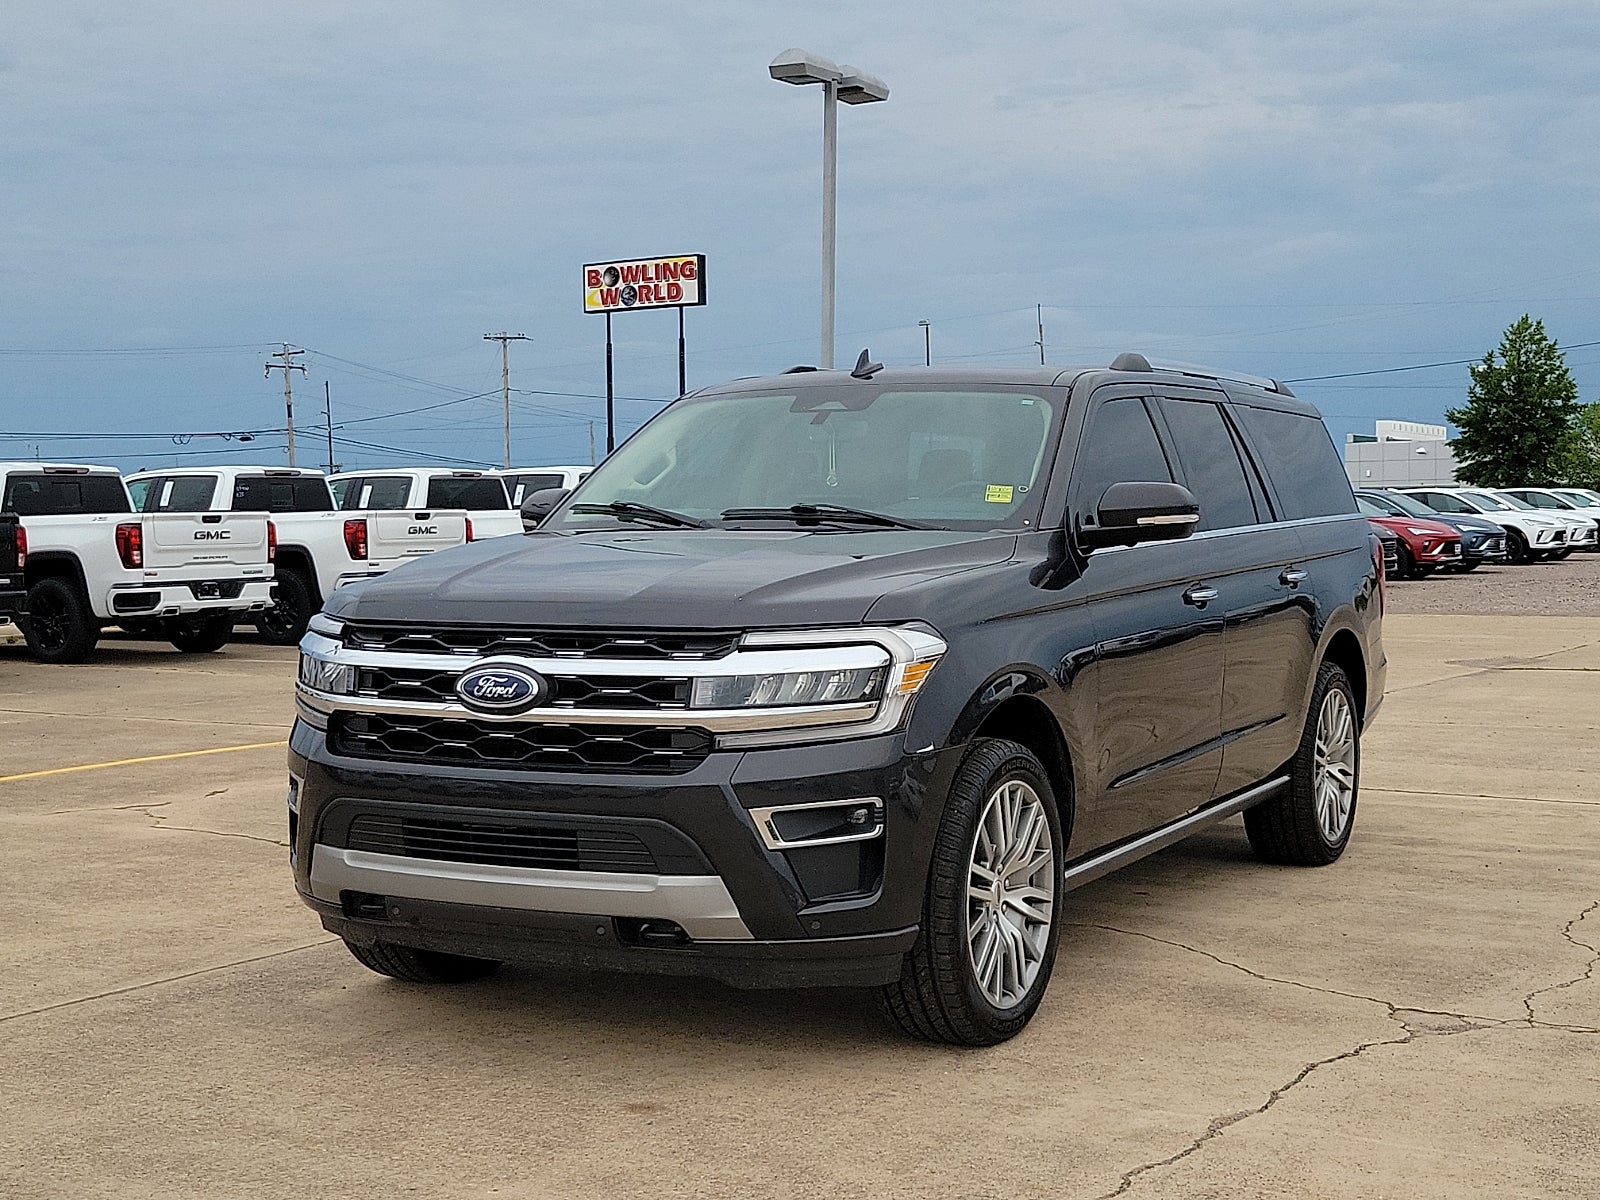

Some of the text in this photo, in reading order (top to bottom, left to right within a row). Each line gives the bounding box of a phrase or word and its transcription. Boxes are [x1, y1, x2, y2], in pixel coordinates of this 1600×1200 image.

[587, 261, 696, 288] BOWLING
[600, 282, 683, 307] WORLD
[194, 530, 231, 540] GMC
[407, 526, 438, 535] GMC
[474, 676, 518, 698] Ford
